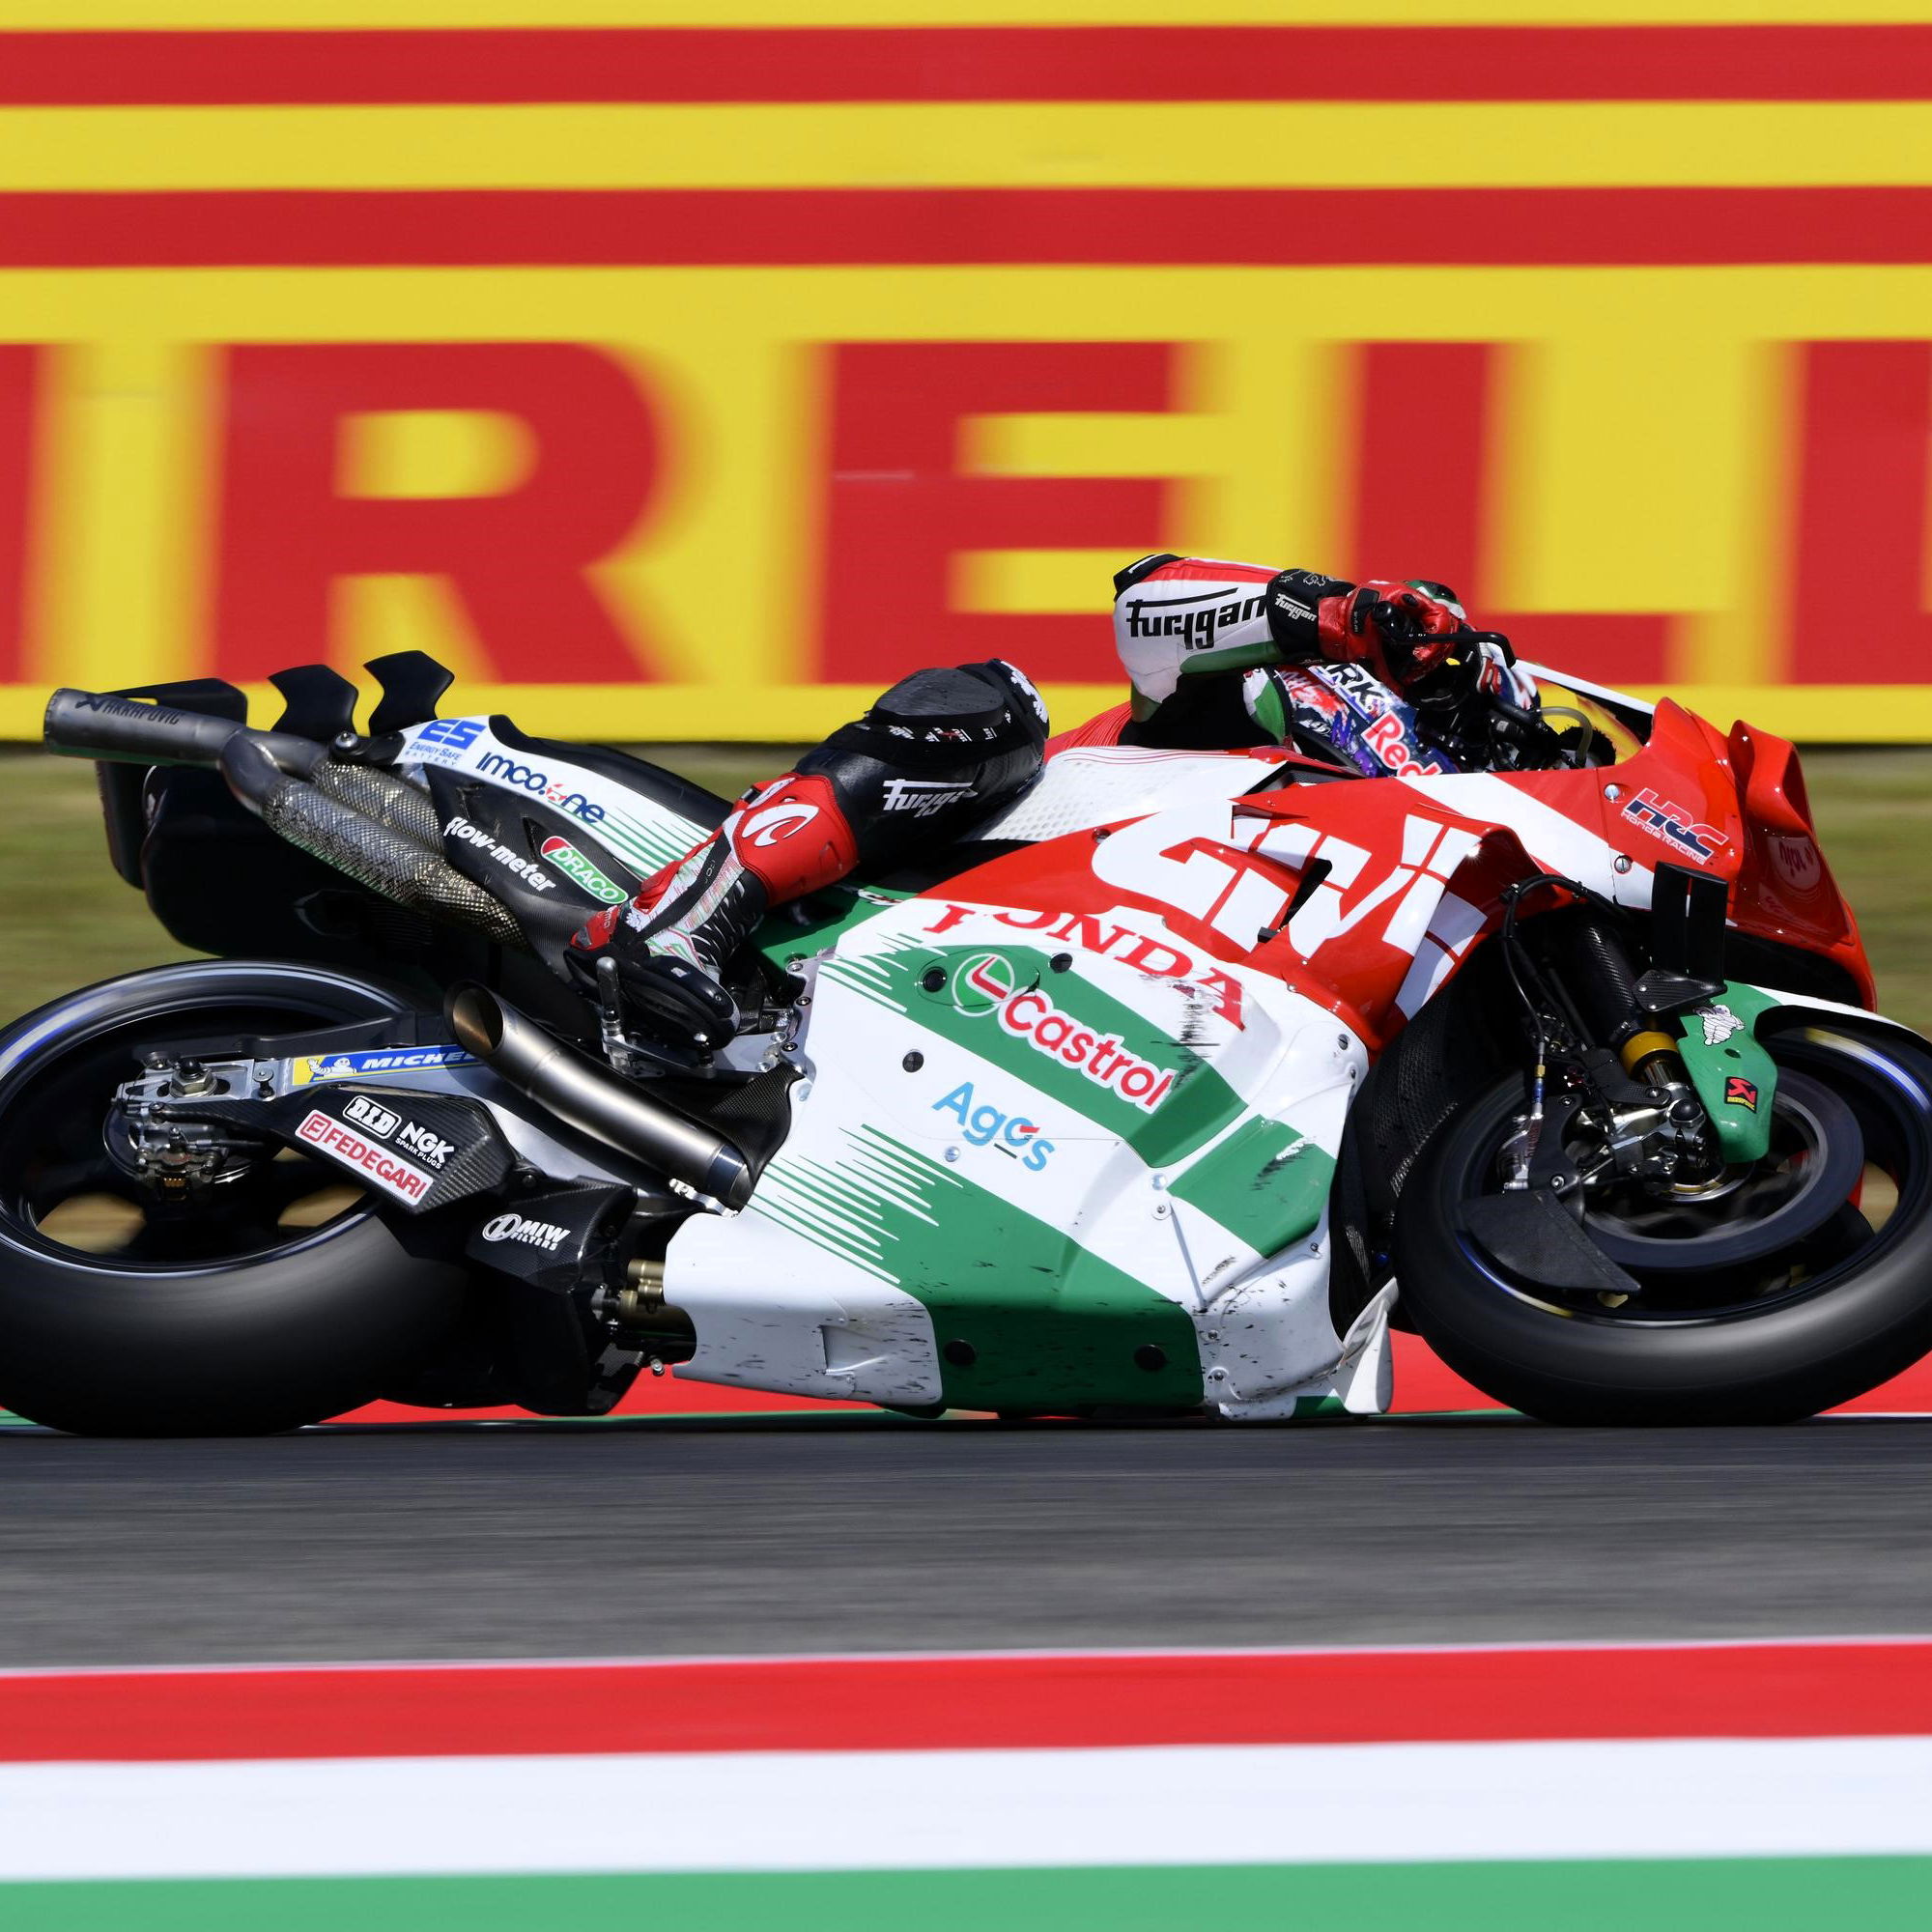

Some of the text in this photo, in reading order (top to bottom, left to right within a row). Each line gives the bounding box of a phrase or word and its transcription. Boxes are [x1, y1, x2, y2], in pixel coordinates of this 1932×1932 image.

[417, 719, 486, 750] ES
[1622, 787, 1729, 858] HRC
[552, 848, 620, 899] DRACO
[1005, 996, 1175, 1107] Castrol
[395, 1137, 441, 1170] SPARK PLUGS
[400, 1121, 454, 1163] NGK
[931, 1082, 1055, 1172] Agos
[324, 1127, 427, 1198] FEDEGARI
